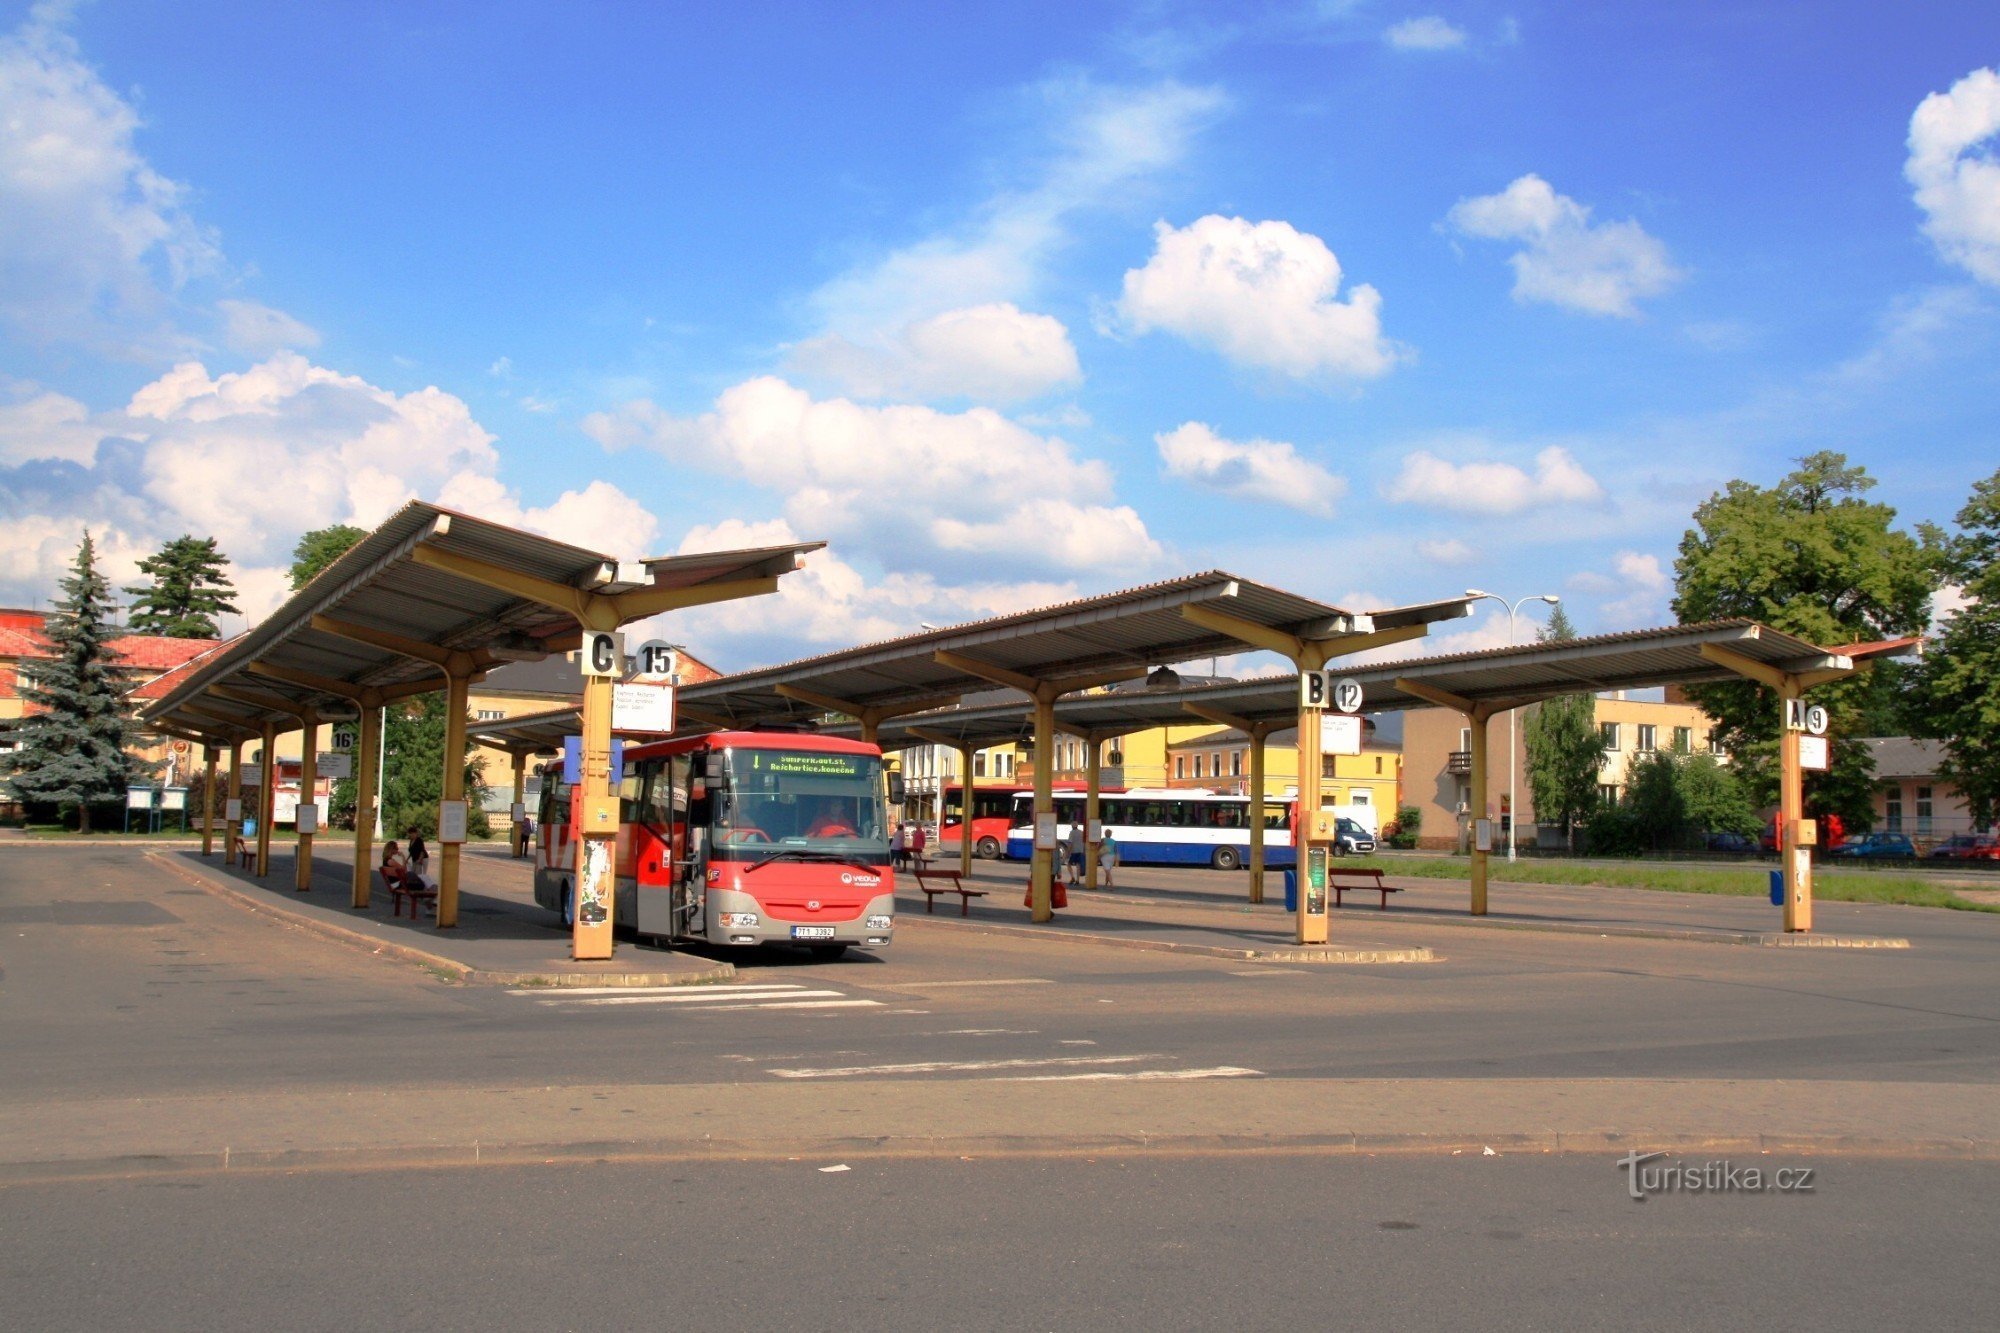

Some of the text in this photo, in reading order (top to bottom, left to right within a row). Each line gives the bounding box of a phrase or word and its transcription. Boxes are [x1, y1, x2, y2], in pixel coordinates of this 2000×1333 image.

[592, 634, 614, 673] C
[641, 646, 671, 673] 15
[1309, 673, 1324, 704] B
[1339, 684, 1358, 707] 12
[1790, 701, 1802, 728] A
[1812, 710, 1822, 729] 9
[334, 733, 351, 748] 16
